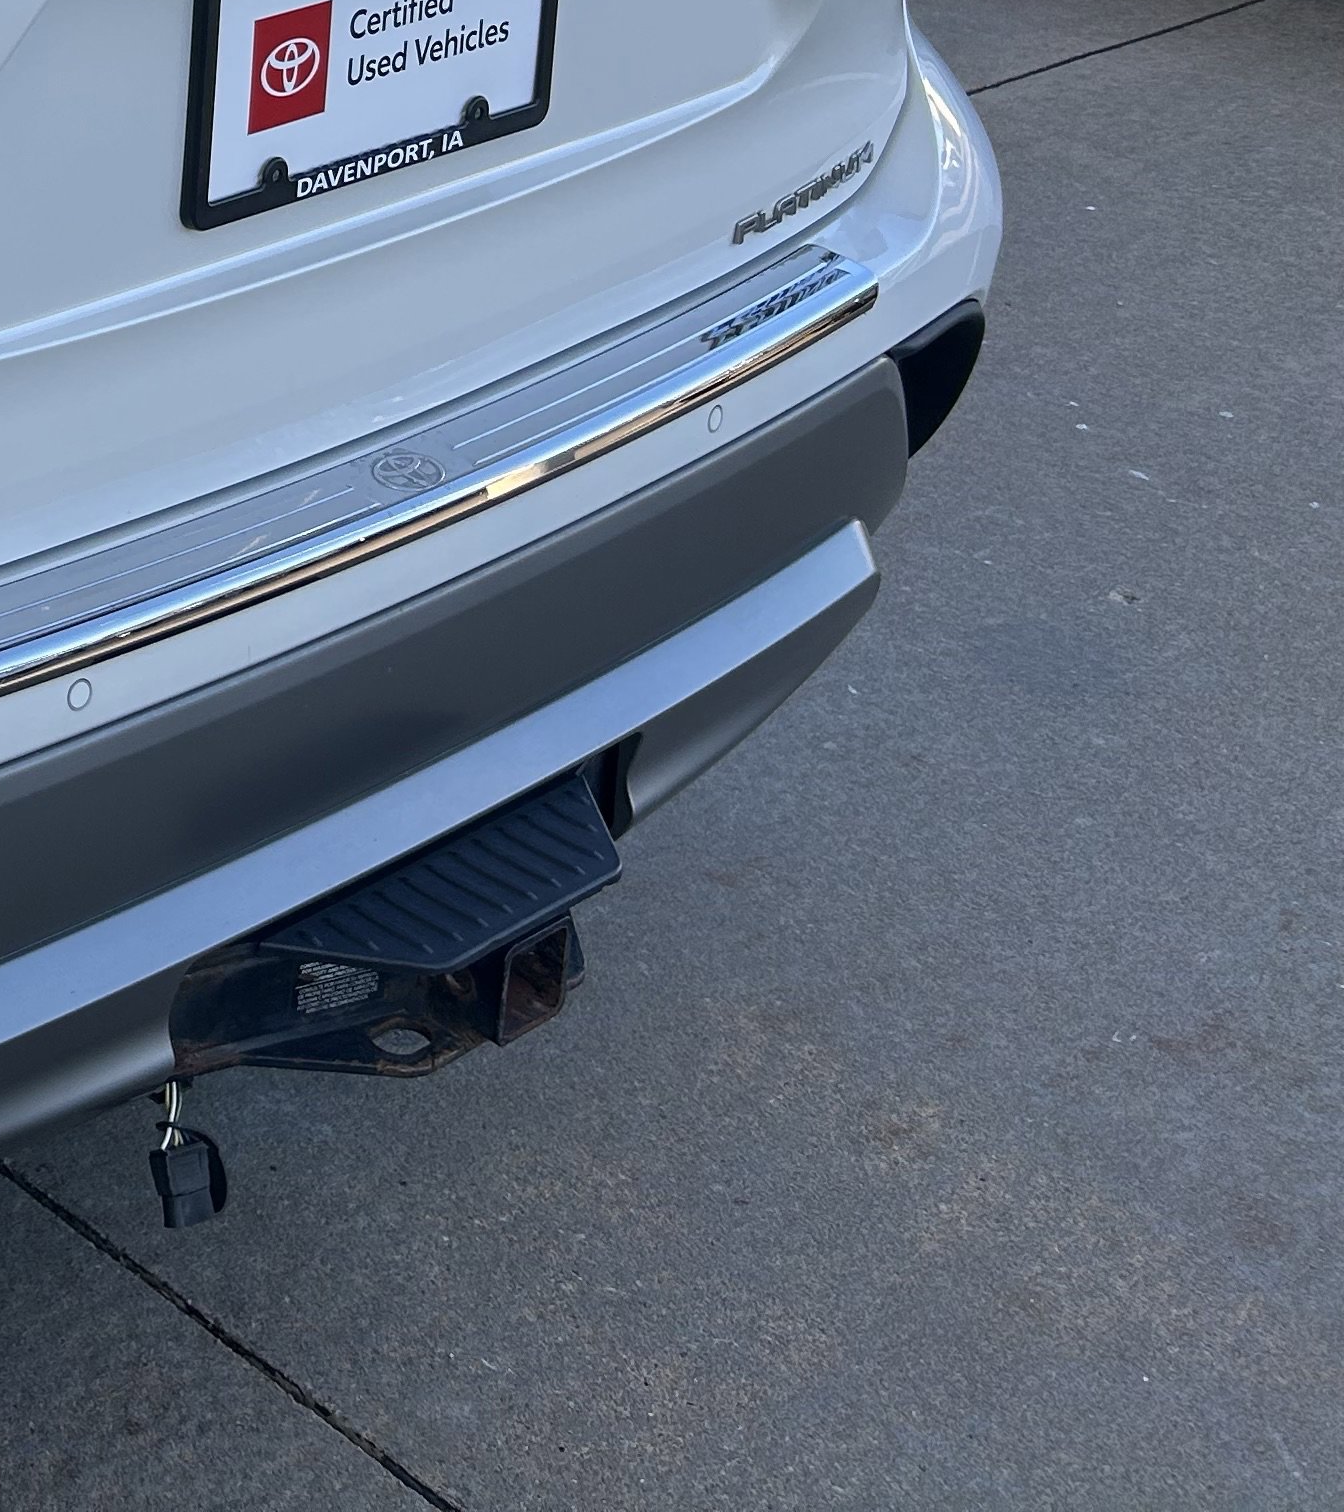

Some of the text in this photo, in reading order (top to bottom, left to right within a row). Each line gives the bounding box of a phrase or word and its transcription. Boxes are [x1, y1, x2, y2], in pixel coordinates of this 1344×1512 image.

[347, 19, 510, 86] Used Vehicles
[296, 130, 463, 198] DAVENPORT, IA
